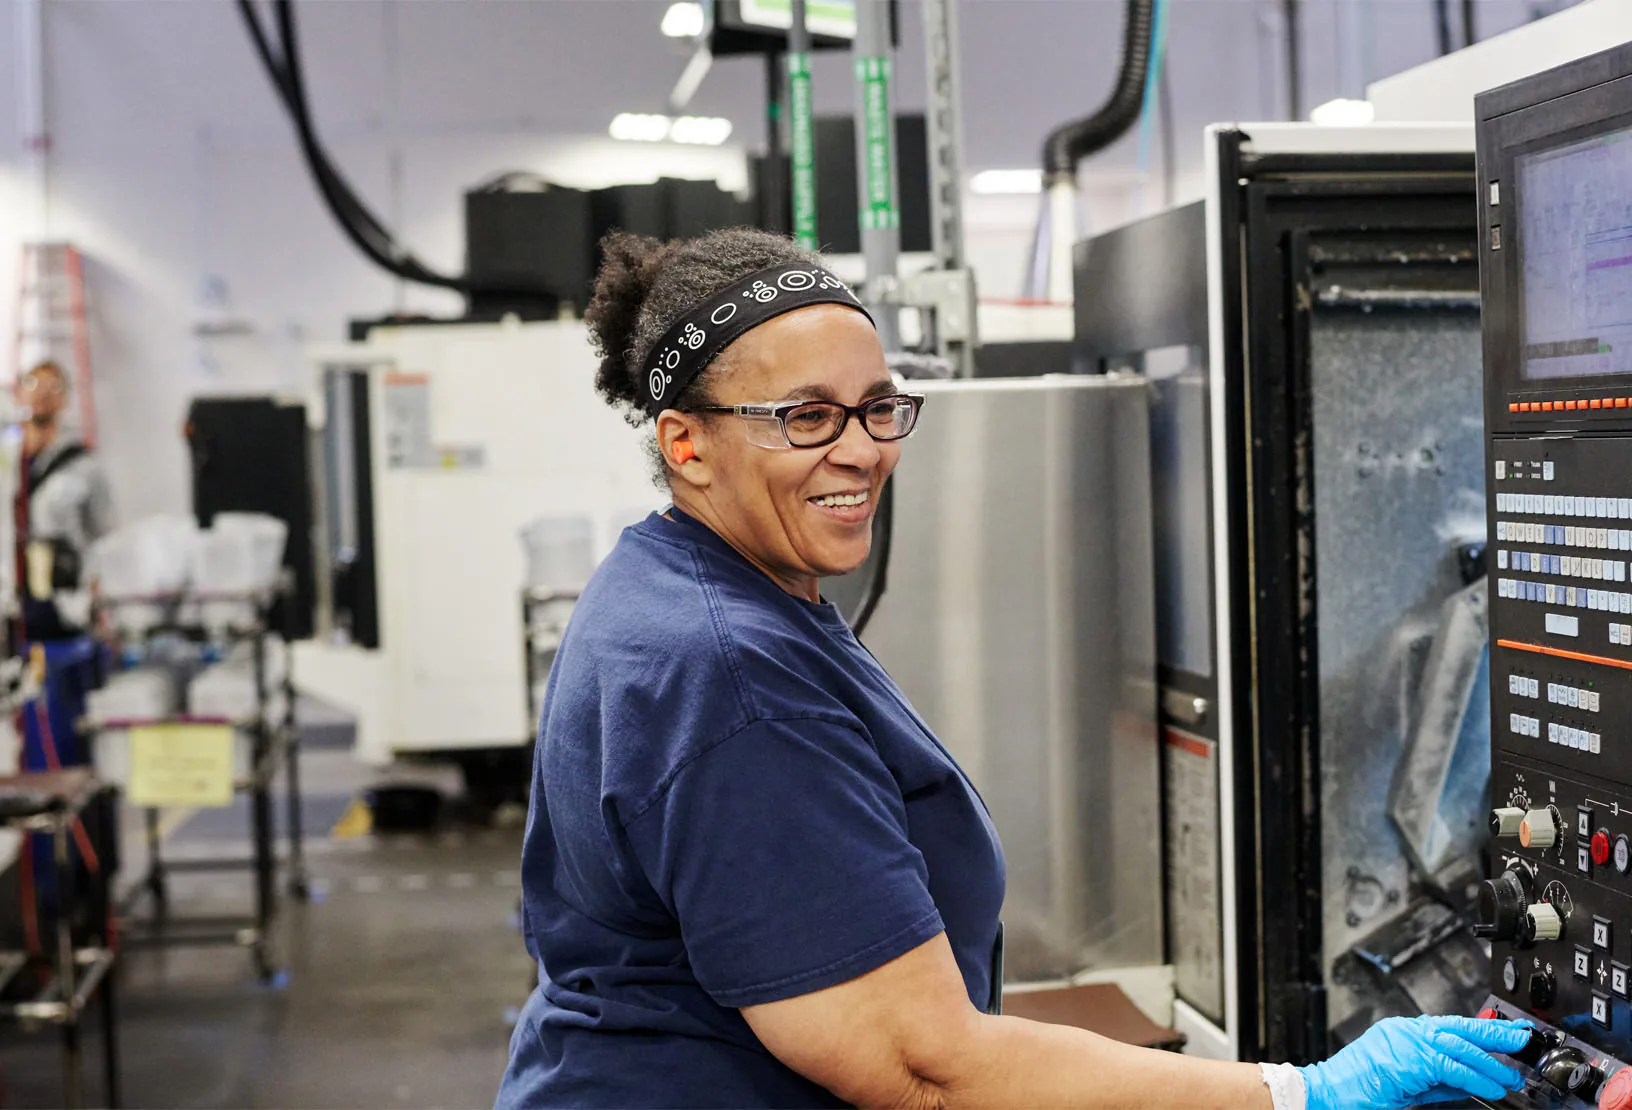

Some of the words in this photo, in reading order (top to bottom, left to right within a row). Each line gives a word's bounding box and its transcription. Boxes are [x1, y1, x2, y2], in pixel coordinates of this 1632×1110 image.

[1598, 928, 1603, 942] X
[1578, 957, 1584, 971] Z
[1616, 974, 1622, 988] Z
[1596, 1003, 1602, 1017] X
